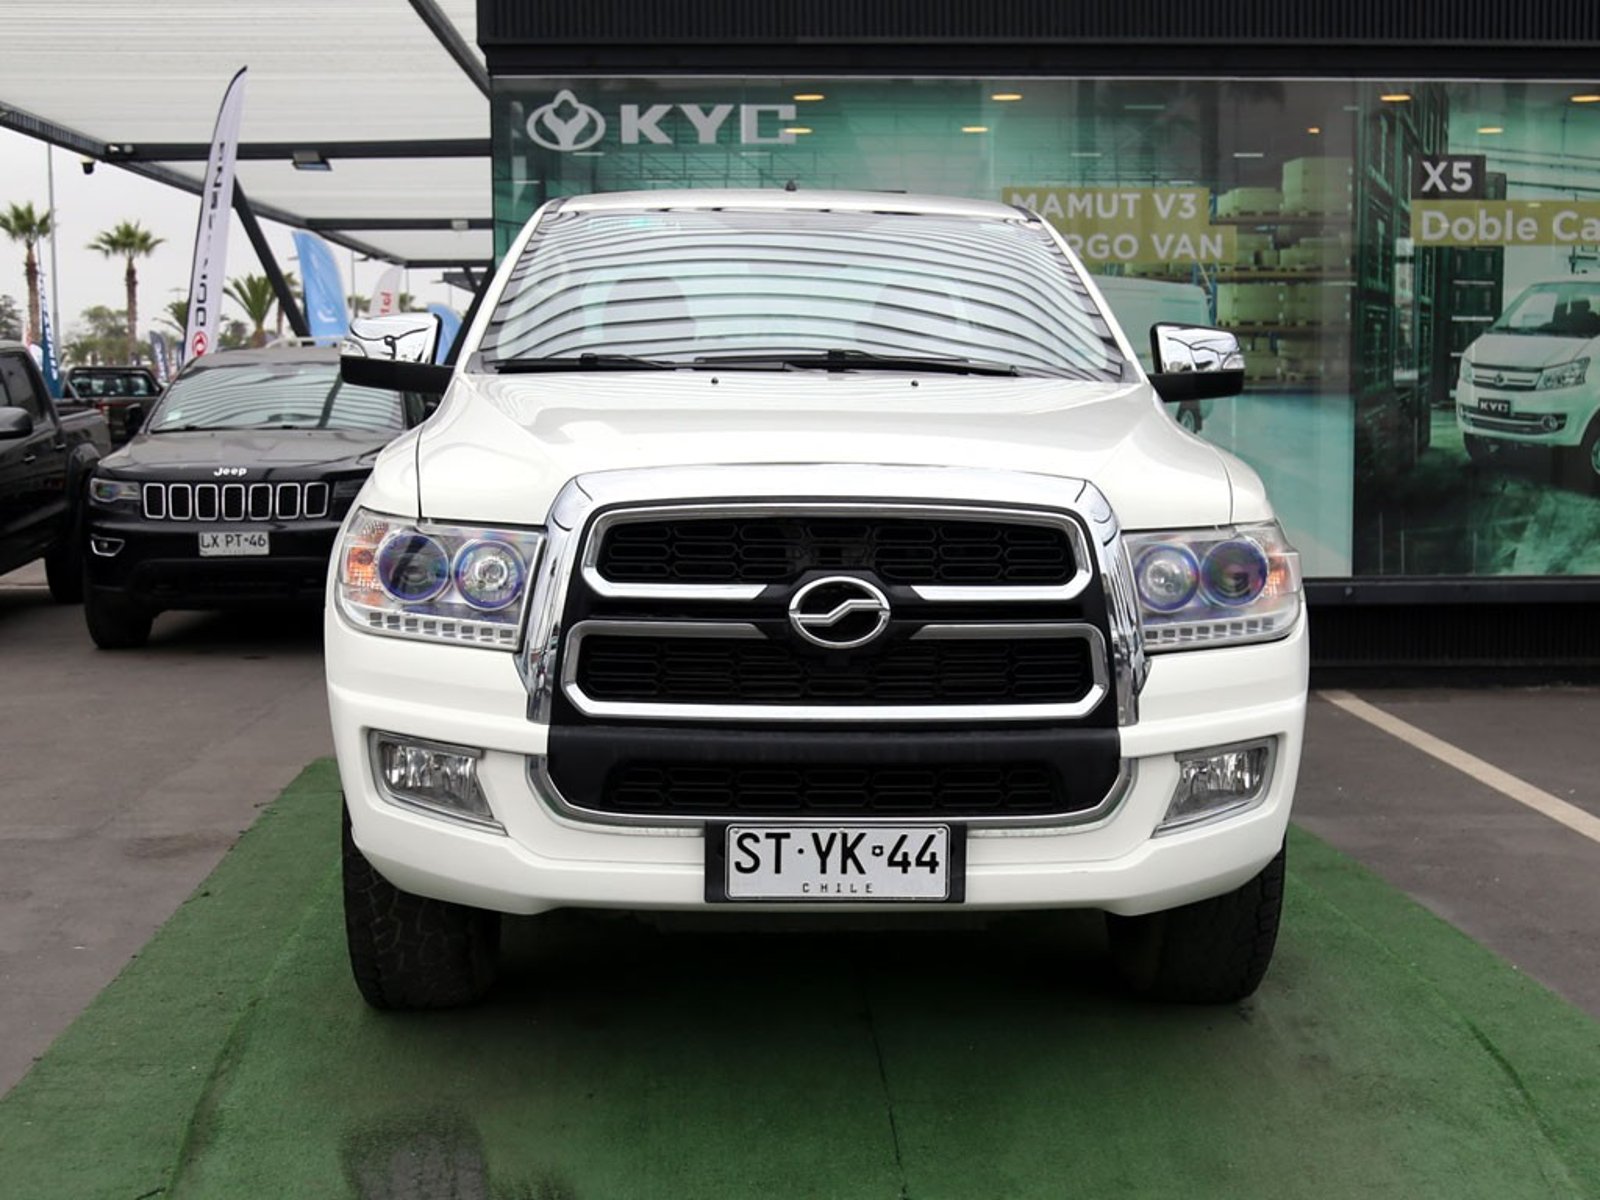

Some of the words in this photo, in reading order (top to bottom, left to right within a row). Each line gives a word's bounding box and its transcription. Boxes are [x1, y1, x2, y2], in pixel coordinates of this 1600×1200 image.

[620, 104, 796, 144] KYC
[1421, 161, 1473, 193] X5
[1010, 193, 1142, 220] MAMUT
[1151, 193, 1197, 220] V3
[1421, 208, 1538, 241] Doble
[1068, 233, 1139, 260] RGO
[1151, 233, 1223, 260] VAN
[213, 467, 248, 477] Jeep
[802, 883, 874, 893] CHILE
